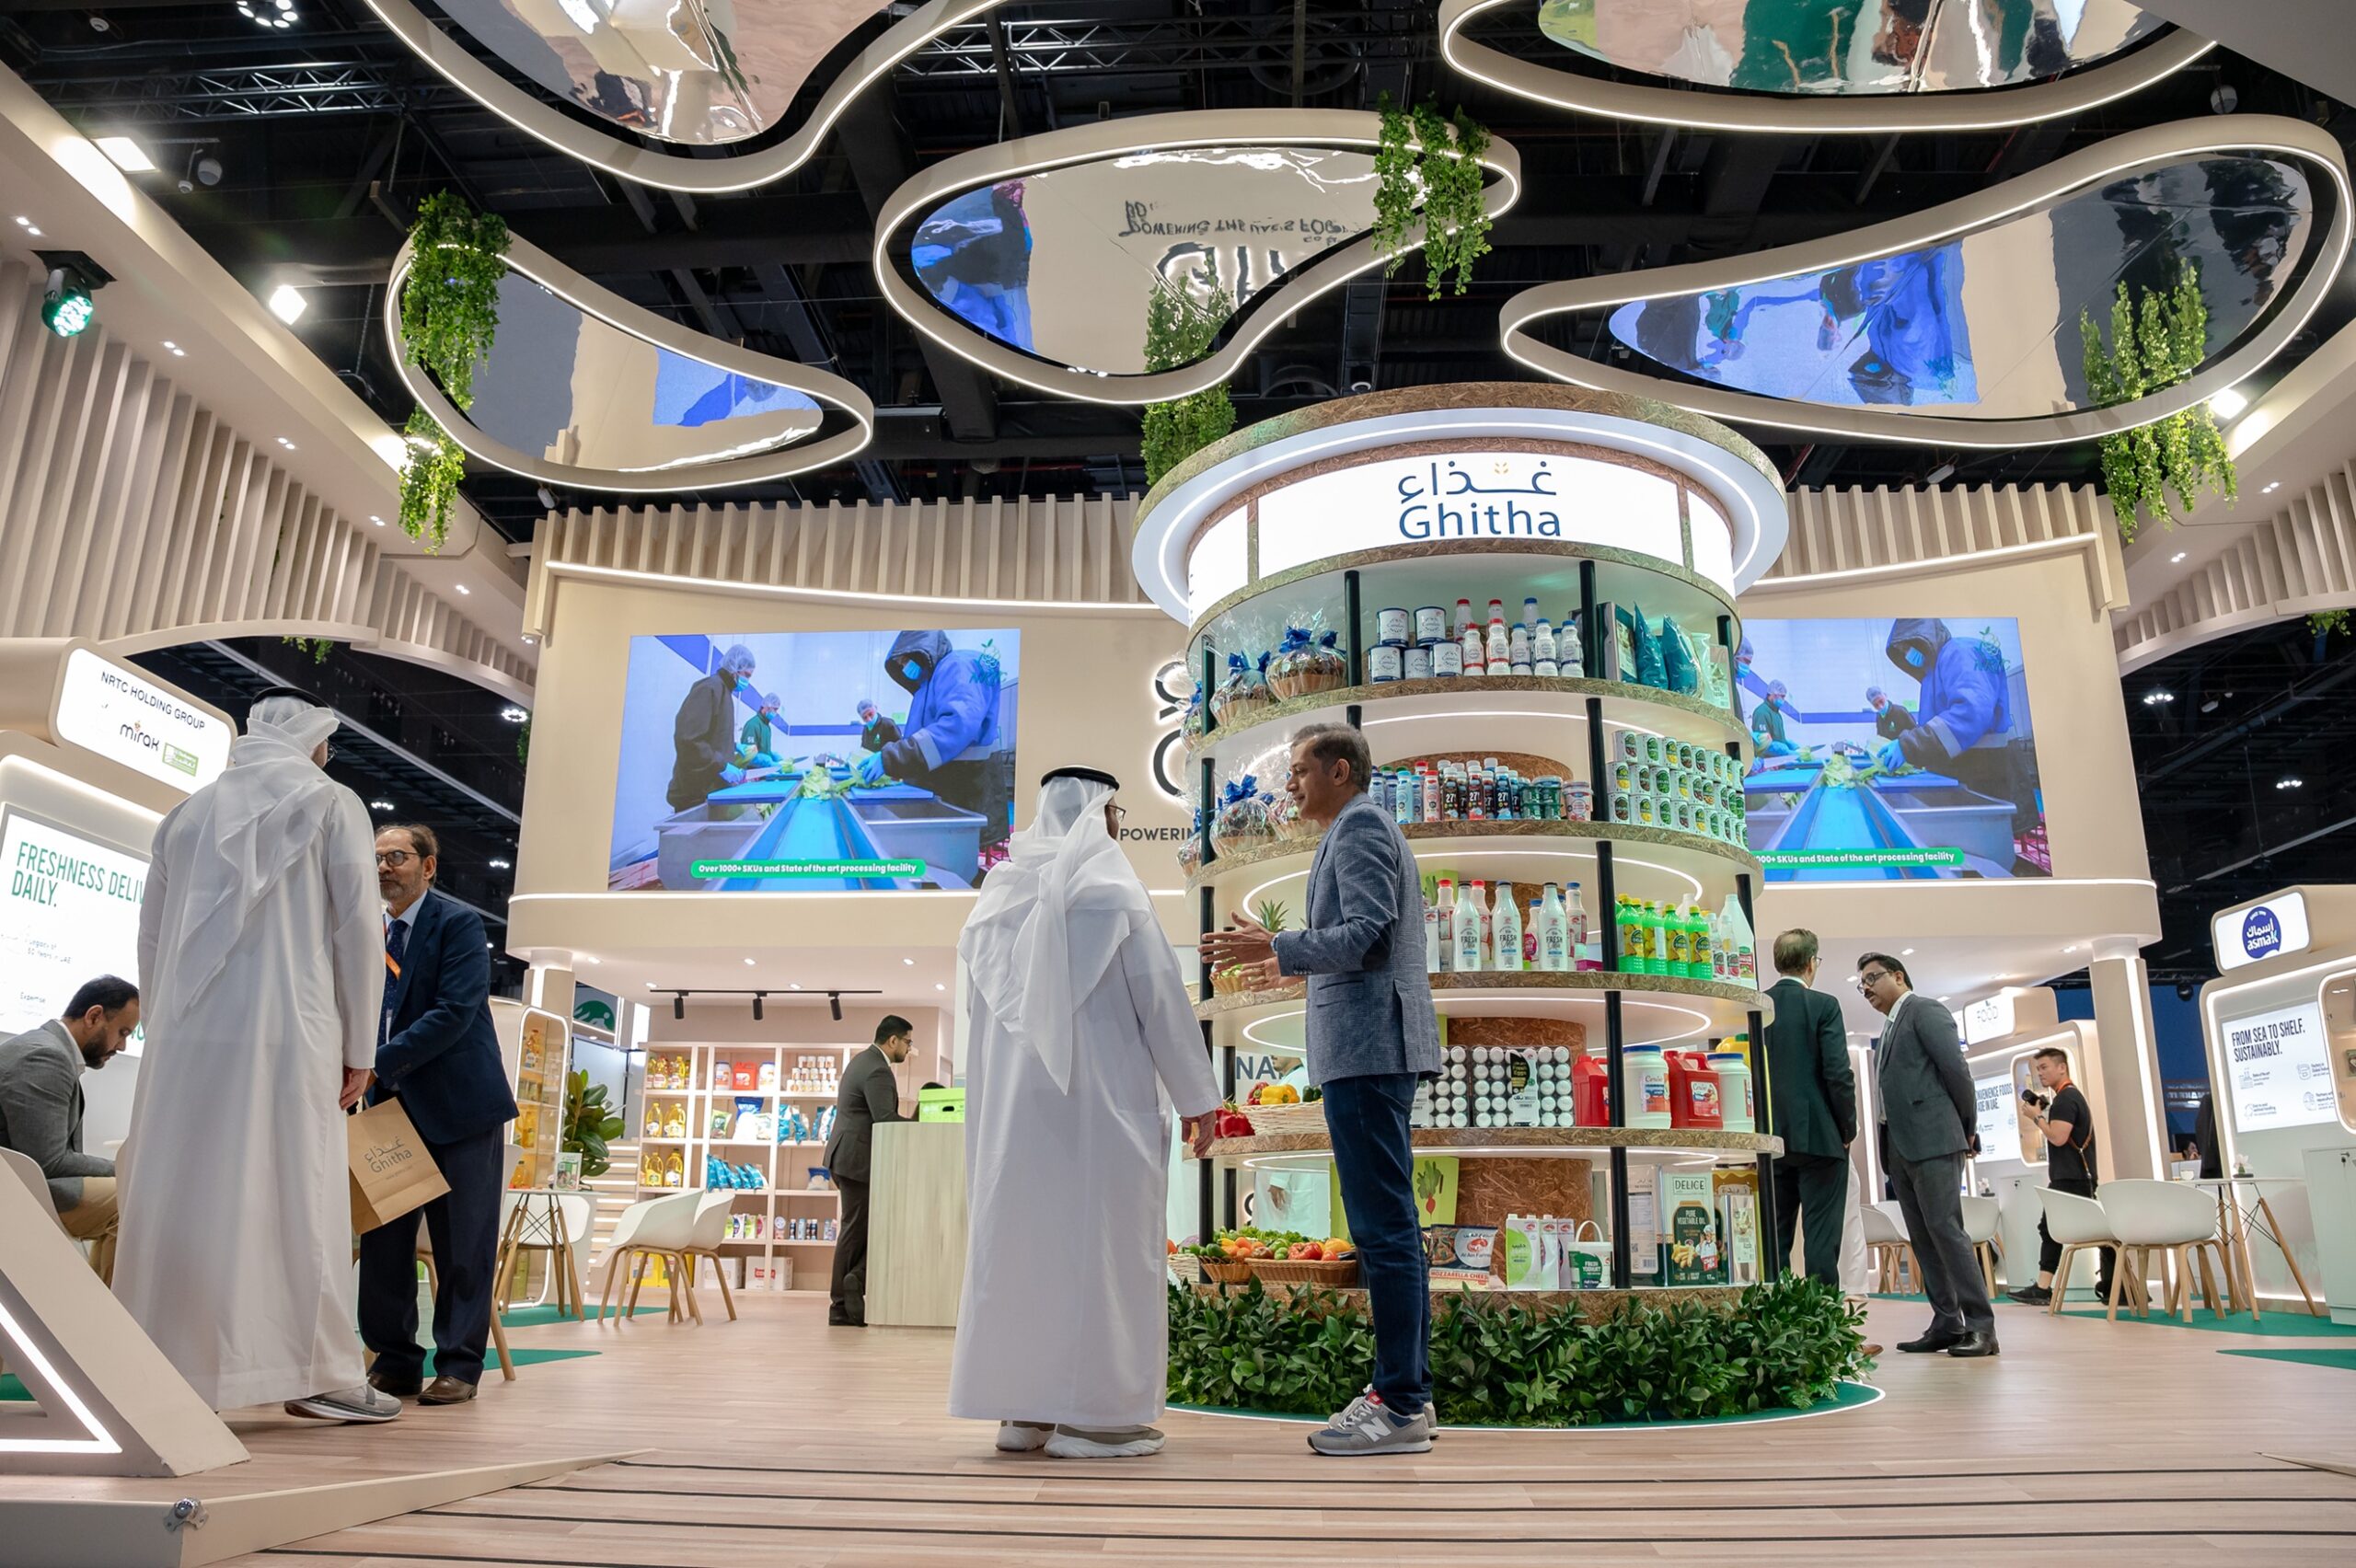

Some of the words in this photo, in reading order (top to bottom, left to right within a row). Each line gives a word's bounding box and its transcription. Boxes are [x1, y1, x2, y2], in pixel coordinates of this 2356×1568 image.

[1398, 500, 1561, 539] Ghitha
[100, 671, 129, 693] NRTC
[130, 686, 172, 715] HOLDING
[174, 708, 206, 731] GROUP
[119, 721, 160, 752] mirak
[1119, 827, 1193, 841] POWERIN
[699, 864, 719, 872] Over
[719, 864, 742, 872] 1000+
[742, 864, 763, 873] SKUs
[764, 863, 780, 872] and
[780, 863, 803, 872] State
[803, 863, 812, 872] of
[812, 863, 826, 872] the
[826, 864, 839, 872] art
[840, 862, 886, 874] processing
[886, 862, 917, 873] facility
[1776, 855, 1798, 863] SKUs
[1799, 854, 1816, 862] and
[1817, 854, 1839, 862] State
[1840, 854, 1849, 862] of
[1849, 853, 1863, 862] the
[1877, 851, 1924, 863] processing
[1924, 851, 1955, 862] facility
[17, 840, 104, 893] FRESHNESS
[108, 870, 144, 905] DELIV
[11, 870, 58, 908] DAILY.
[2231, 1029, 2252, 1046] FROM
[2252, 1026, 2267, 1043] SEA
[2268, 1023, 2279, 1040] TO
[2279, 1018, 2305, 1038] SHELF.
[2234, 1040, 2282, 1063] SUSTAINABLY.
[1236, 1055, 1282, 1080] NA
[370, 1149, 413, 1173] Ghitha
[1675, 1180, 1704, 1190] DELICE
